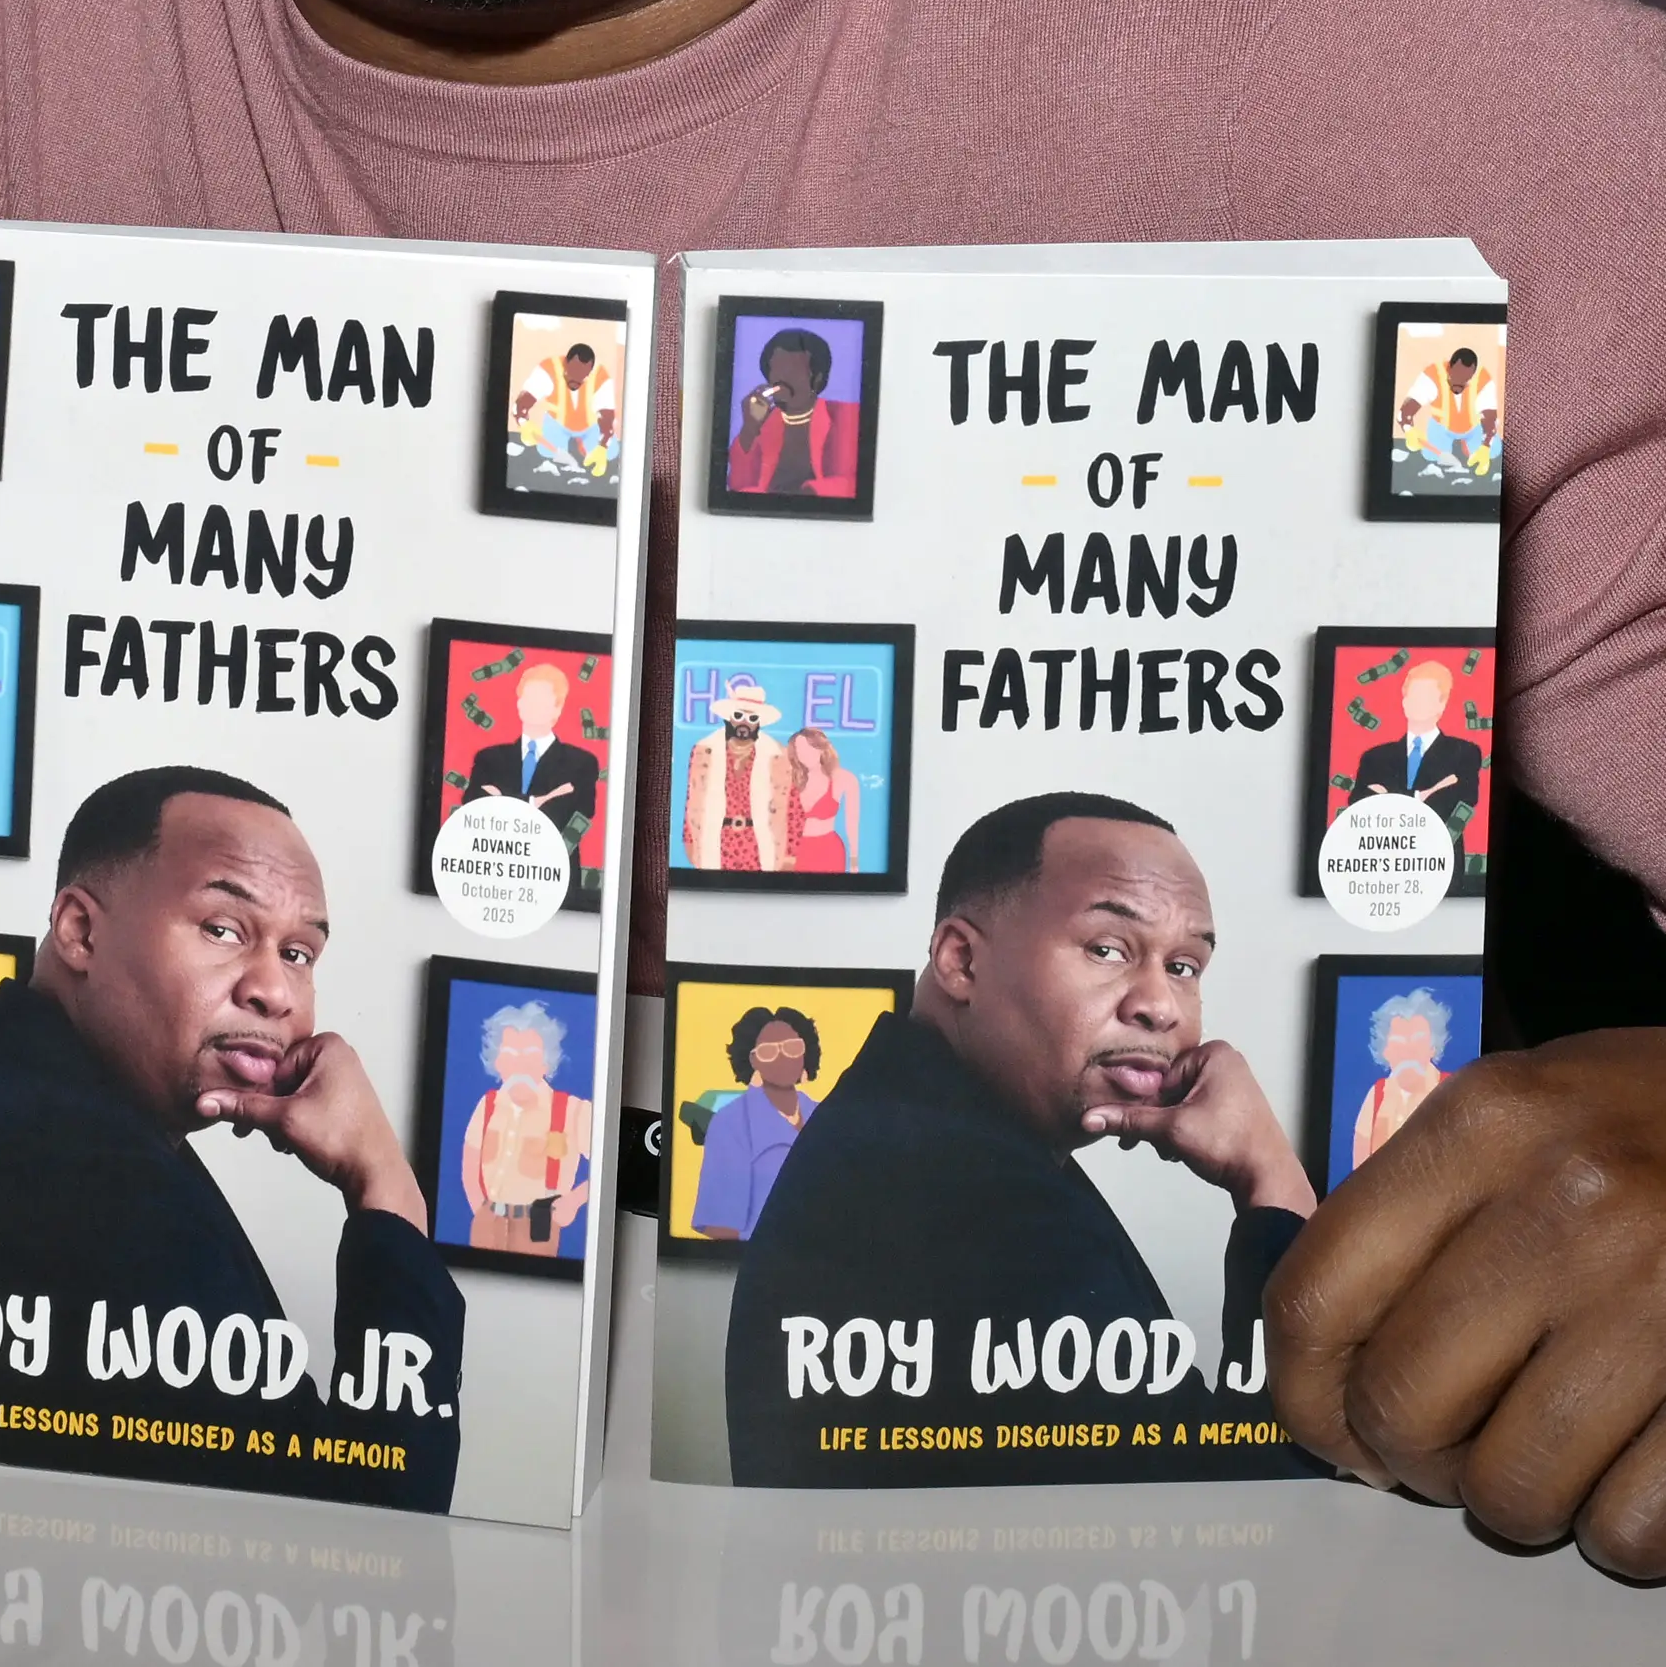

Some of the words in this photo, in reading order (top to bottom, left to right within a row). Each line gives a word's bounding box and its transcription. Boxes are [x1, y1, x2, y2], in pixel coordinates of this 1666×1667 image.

[61, 302, 217, 393] THE
[256, 312, 435, 409] MAN
[933, 338, 1097, 425] THE
[1136, 341, 1319, 426] MAN
[206, 426, 282, 485] OF
[1085, 452, 1162, 509] OF
[119, 500, 355, 601] MANY
[999, 533, 1238, 617] MANY
[63, 613, 400, 722] FATHERS
[941, 646, 1286, 736] FATHERS
[464, 814, 485, 829] Not
[490, 817, 508, 832] for
[513, 819, 541, 834] Sale
[1350, 814, 1372, 828] Not
[1377, 814, 1394, 827] for
[1399, 814, 1426, 827] Sale
[472, 838, 531, 856] ADVANCE
[1358, 836, 1416, 850] ADVANCE
[441, 858, 503, 877] READER'S
[509, 864, 561, 882] EDITION
[1327, 858, 1389, 873] READER'S
[1395, 857, 1445, 871] EDITION
[462, 882, 513, 901] October
[518, 887, 537, 905] 28,
[1349, 881, 1400, 895] October
[1404, 880, 1423, 894] 28,
[483, 907, 514, 923] 2025
[1370, 902, 1400, 916] 2025
[87, 1299, 309, 1402] WOOD
[337, 1328, 455, 1420] JR.
[782, 1315, 934, 1400] ROY
[971, 1317, 1197, 1395] WOOD
[112, 1416, 235, 1453] DISGUISED
[246, 1428, 276, 1456] AS
[288, 1432, 302, 1460] A
[312, 1435, 407, 1472] MEMOIR
[820, 1426, 867, 1451] LIFE
[879, 1425, 984, 1451] LESSONS
[996, 1422, 1121, 1450] DISGUISED
[1131, 1422, 1159, 1446] AS
[1172, 1422, 1188, 1446] A
